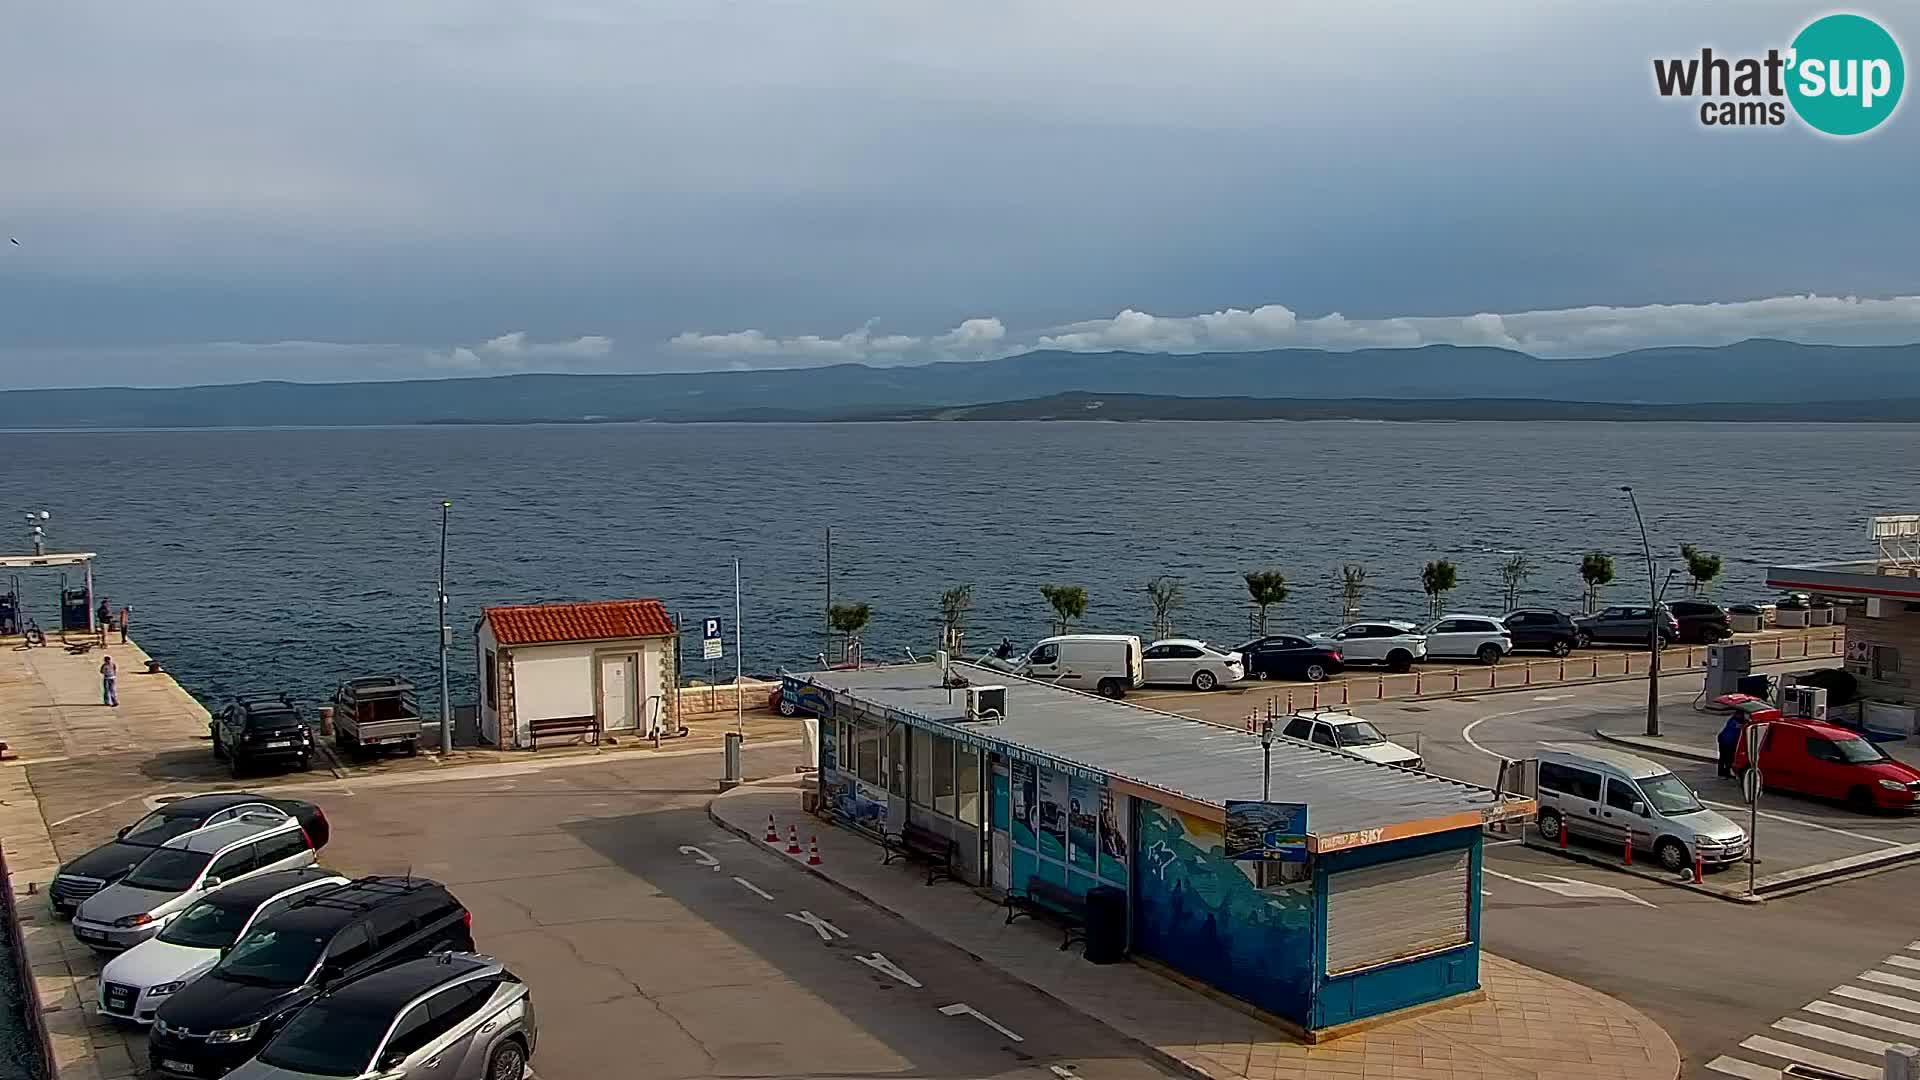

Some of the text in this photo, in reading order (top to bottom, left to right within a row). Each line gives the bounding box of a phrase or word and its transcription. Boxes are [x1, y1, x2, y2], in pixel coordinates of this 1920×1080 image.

[707, 620, 717, 637] P
[1006, 747, 1020, 759] BUS
[1021, 751, 1051, 768] STATION
[1054, 761, 1077, 777] TICKET
[1079, 769, 1104, 784] OFFICE
[1360, 827, 1384, 845] SKY
